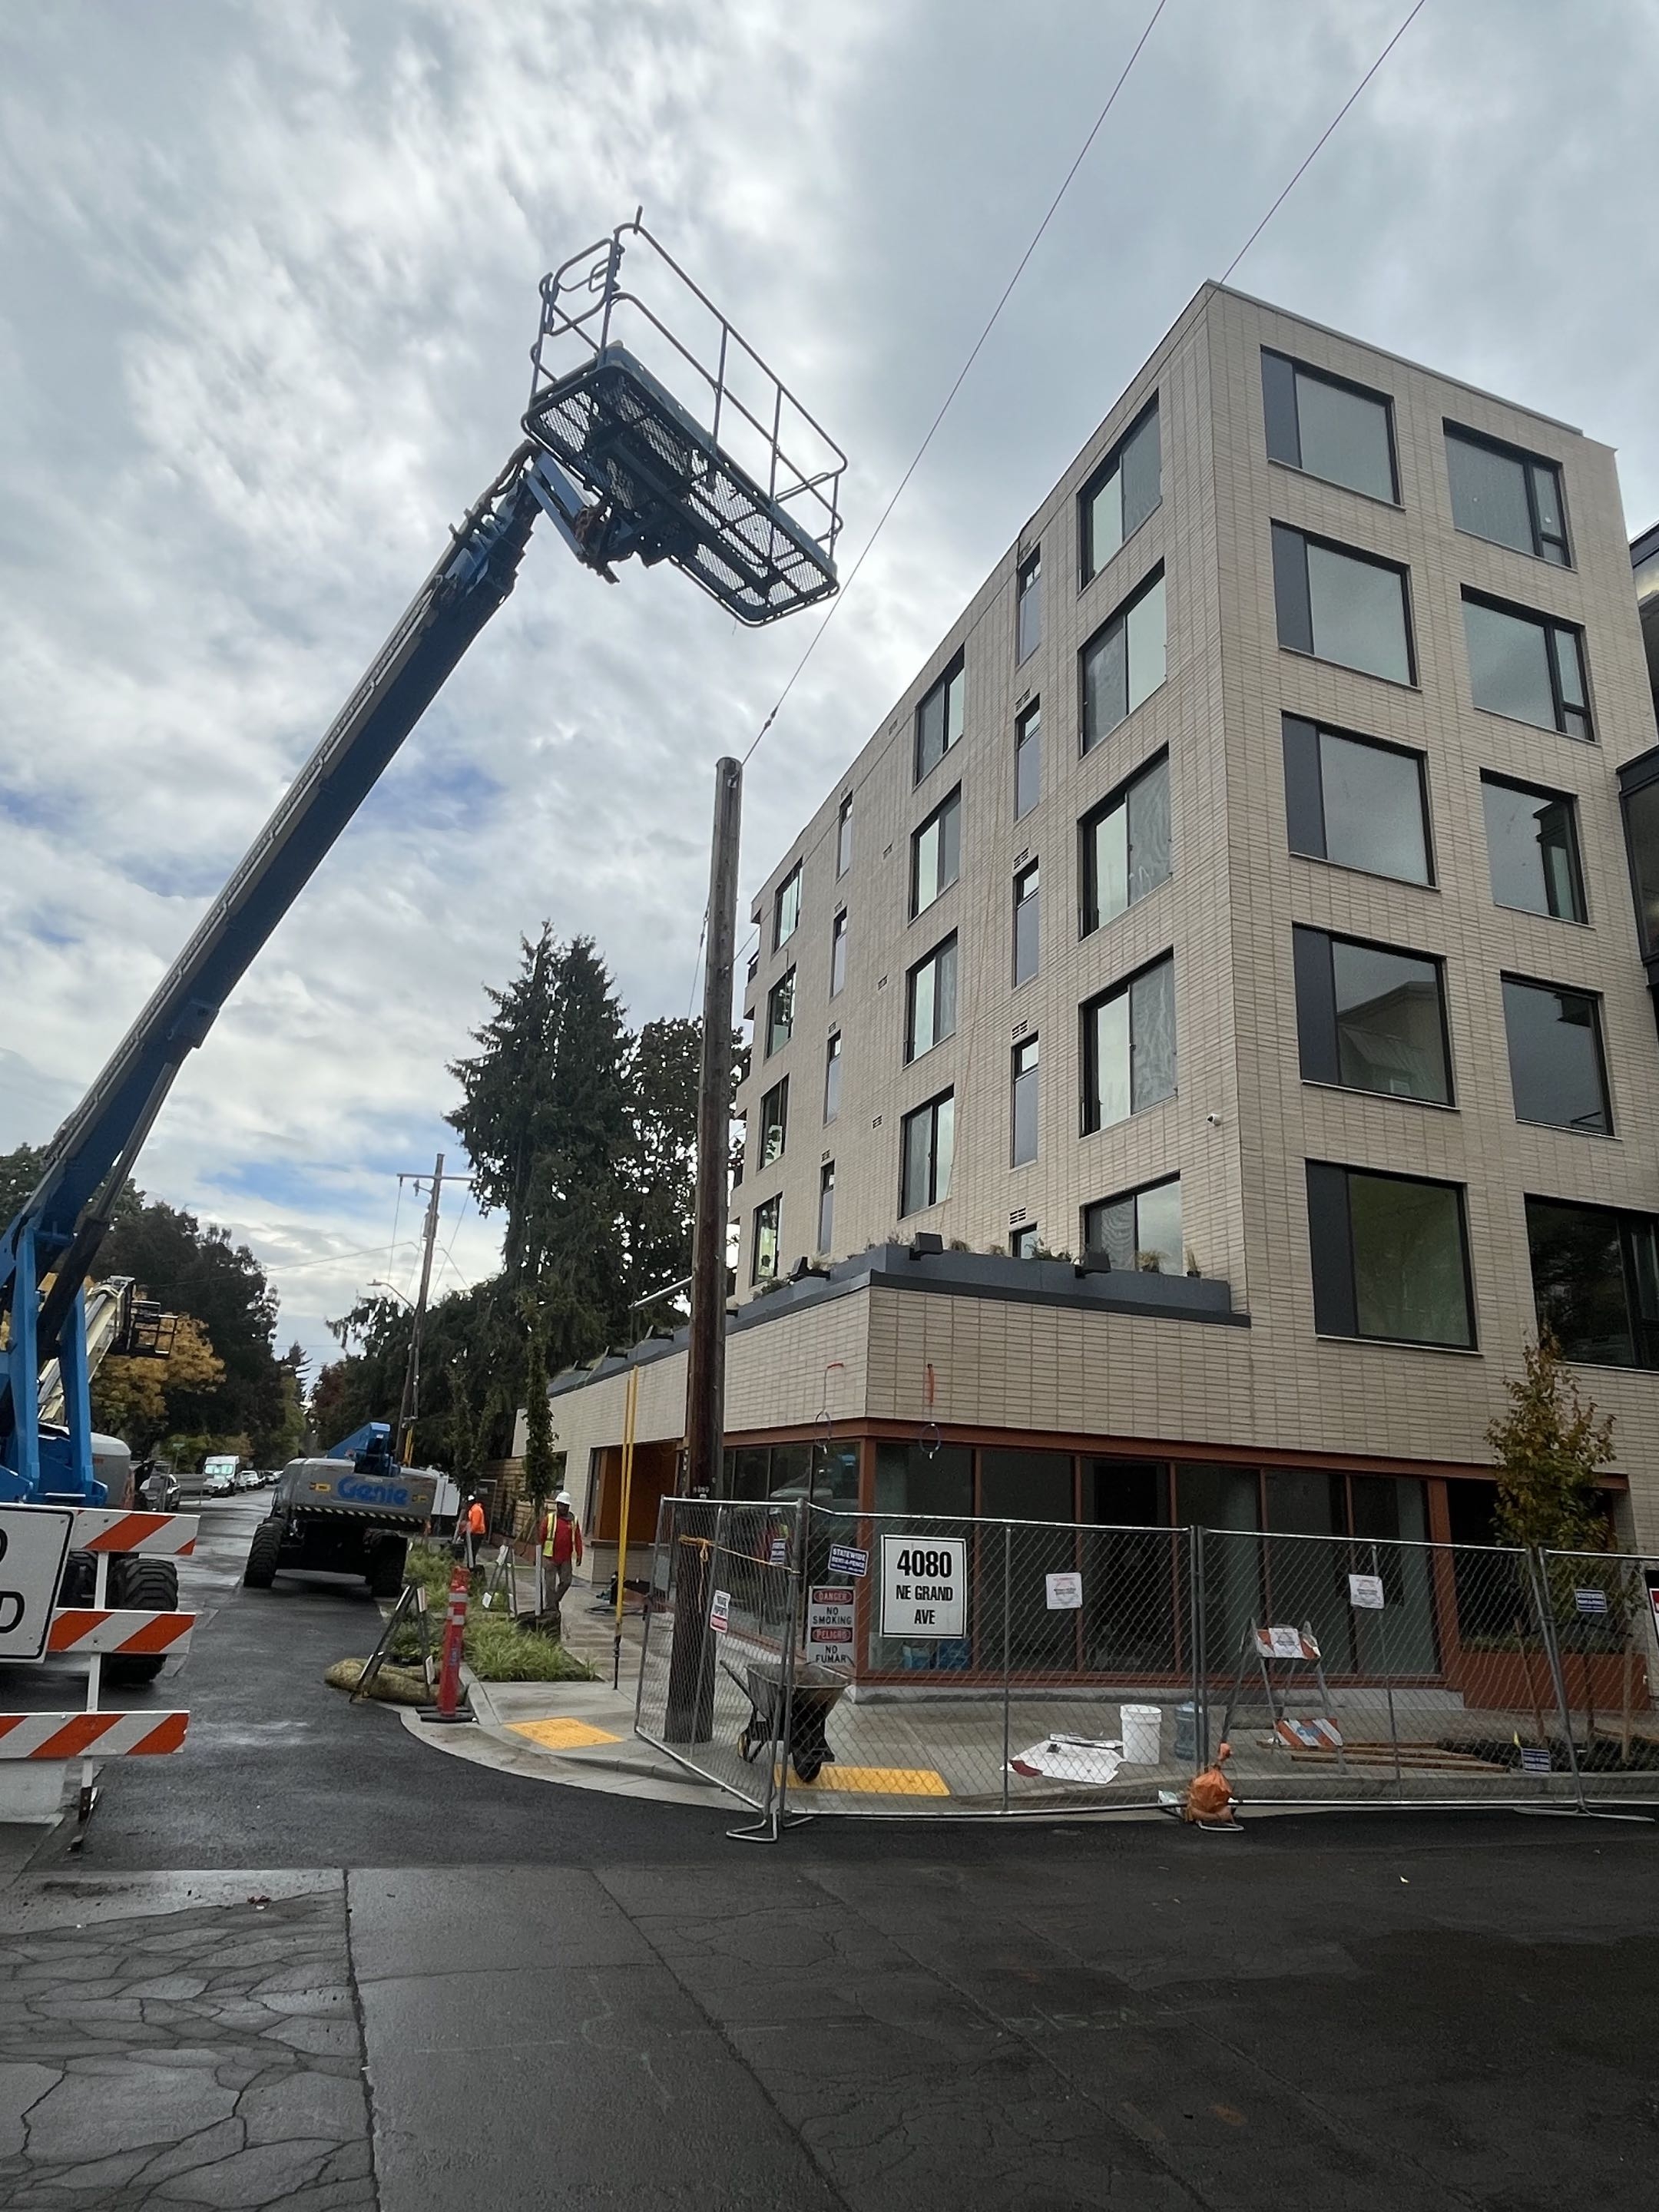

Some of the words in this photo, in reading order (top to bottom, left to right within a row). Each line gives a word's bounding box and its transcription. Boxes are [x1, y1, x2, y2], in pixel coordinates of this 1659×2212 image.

[338, 1475, 409, 1505] Genie
[833, 1548, 866, 1561] STATEWIDE
[896, 1549, 952, 1578] 4080
[817, 1591, 848, 1601] DANGER
[896, 1584, 912, 1600] NE
[915, 1585, 953, 1601] GRAND
[826, 1606, 839, 1615] NO
[813, 1615, 853, 1625] SMOKING
[914, 1608, 935, 1624] AVE
[816, 1630, 849, 1640] PELIGRO
[825, 1645, 838, 1654] NO
[815, 1654, 846, 1664] FUMAR
